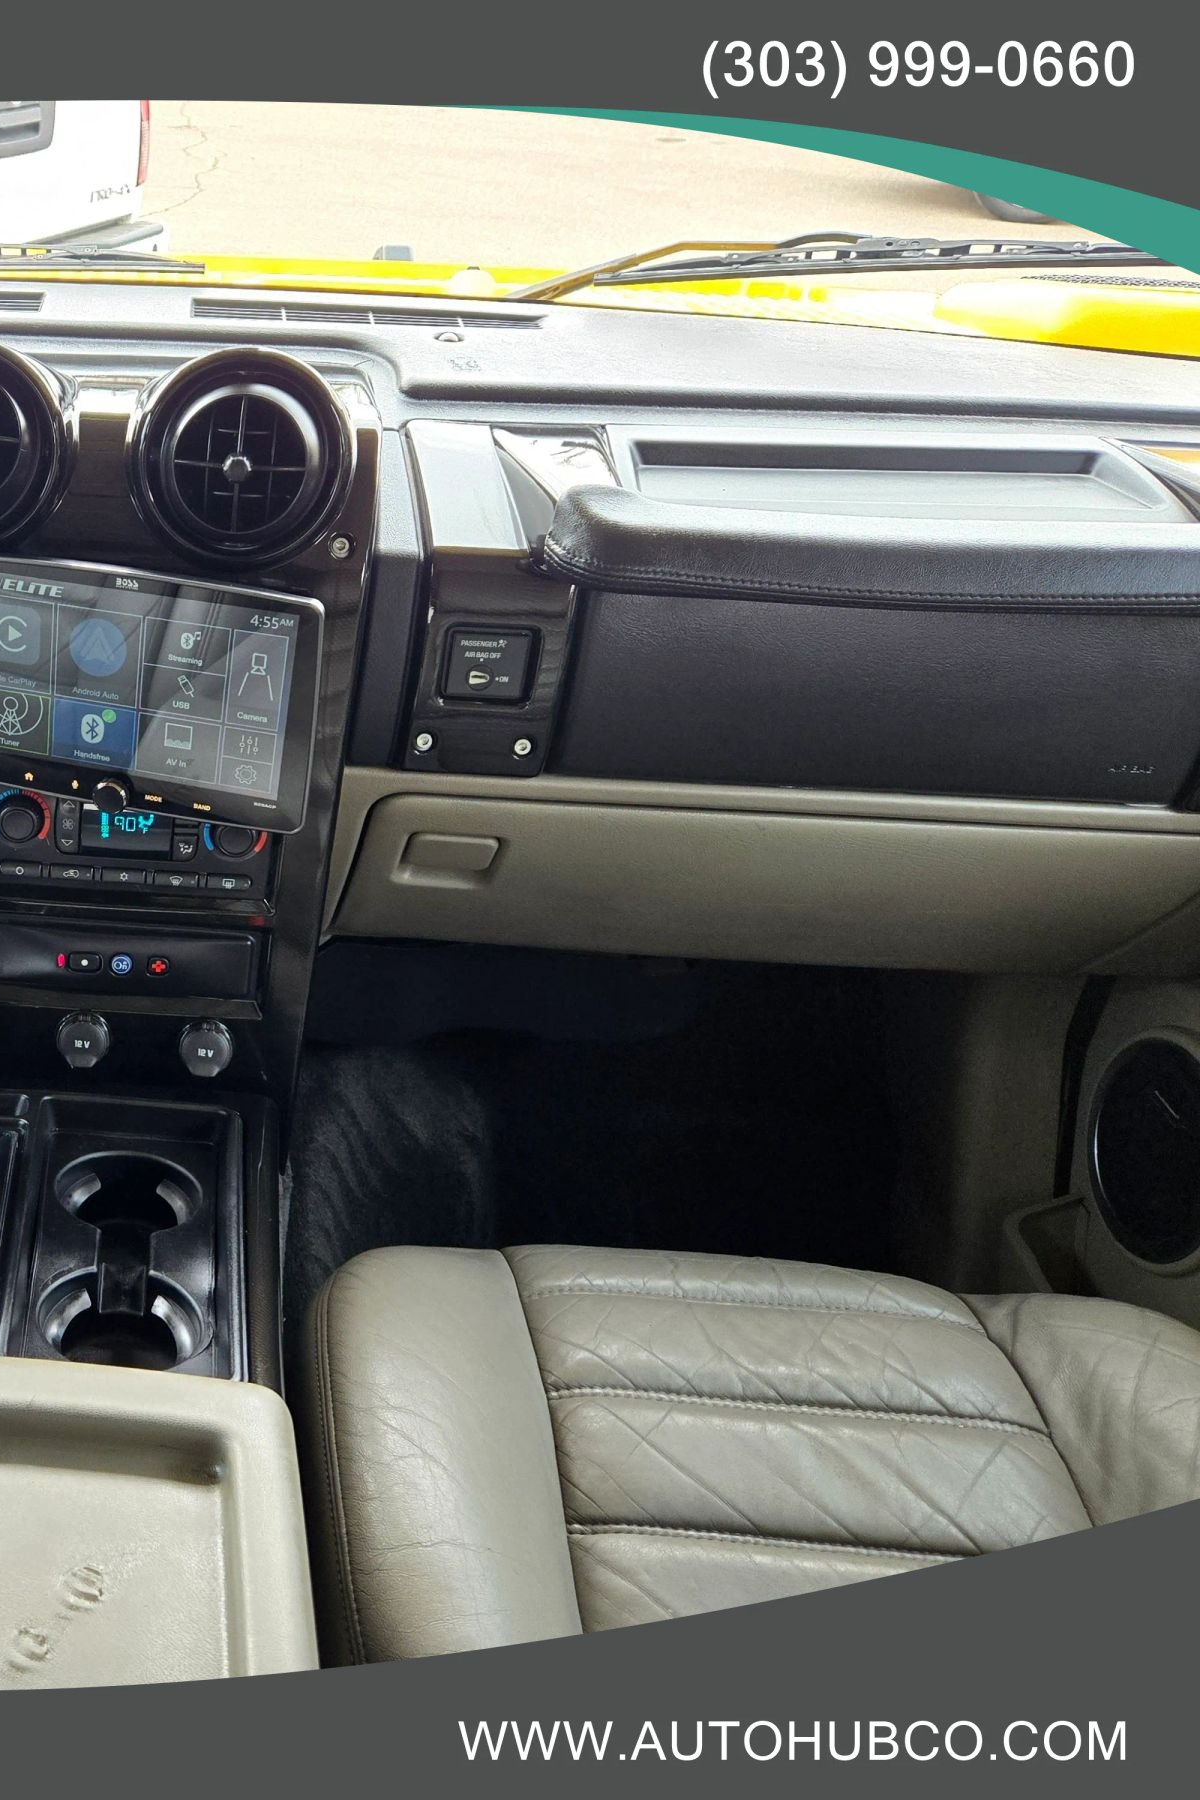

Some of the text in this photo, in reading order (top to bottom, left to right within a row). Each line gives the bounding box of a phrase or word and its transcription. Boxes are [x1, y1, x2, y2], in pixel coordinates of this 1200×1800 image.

[461, 640, 498, 648] PASSENGER
[167, 653, 203, 667] Streaming
[7, 676, 37, 688] CarPlay
[72, 686, 119, 700] Android Auto
[172, 700, 191, 710] USB
[236, 711, 268, 723] Camera
[0, 737, 20, 747] Tuner
[73, 749, 111, 762] Handsfree
[165, 757, 178, 766] AV
[144, 794, 162, 803] MODE
[193, 802, 211, 812] BAND
